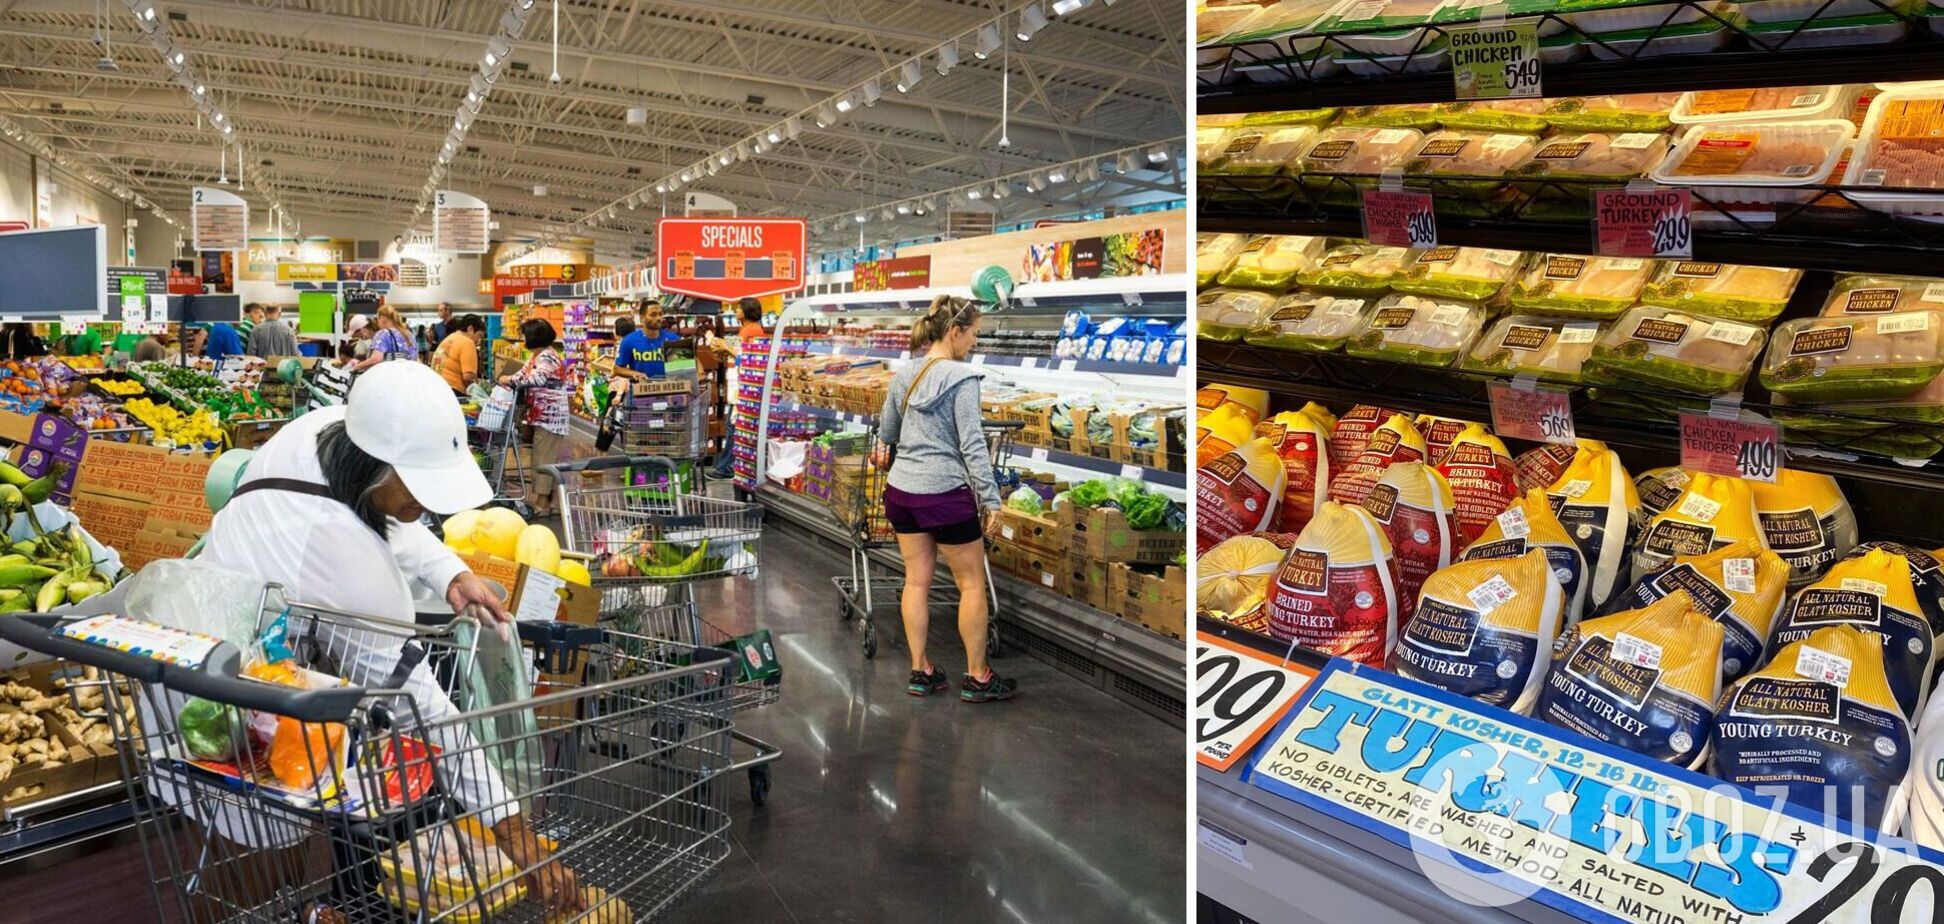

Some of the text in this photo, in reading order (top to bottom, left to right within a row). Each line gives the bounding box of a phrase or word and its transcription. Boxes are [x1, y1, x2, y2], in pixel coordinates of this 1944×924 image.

[195, 191, 204, 202] 2
[437, 193, 446, 205] 3
[688, 195, 696, 207] 4
[1603, 193, 1680, 208] GROUND
[1367, 206, 1406, 219] CHICKEN
[1600, 208, 1662, 224] TURKEY
[701, 225, 763, 248] SPECIALS
[1547, 267, 1579, 276] CHICKEN
[1678, 264, 1719, 274] CHICKEN
[1849, 300, 1892, 309] CHICKEN
[1523, 330, 1550, 338] NATURAL
[1637, 327, 1682, 340] CHICKEN
[1652, 321, 1686, 333] NATURAL
[1505, 336, 1546, 346] CHICKEN
[1812, 331, 1849, 341] NATURAL
[1794, 337, 1846, 352] CHICKEN
[639, 382, 685, 393] FRESH HERBS
[1695, 416, 1714, 427] ALL
[1683, 424, 1736, 444] CHICKEN
[1684, 438, 1737, 456] TENDERS
[1453, 453, 1490, 463] TURKEY
[1448, 468, 1487, 478] BRINED
[159, 508, 184, 521] FARM
[1776, 518, 1812, 531] NATURAL
[1657, 525, 1706, 541] ALL NATURAL
[1785, 531, 1818, 545] KOSHER
[1481, 543, 1517, 558] NATURAL
[1299, 558, 1325, 571] NATURAL
[1282, 566, 1323, 587] TURKEY
[1674, 569, 1720, 609] ALL NATURAL
[1275, 592, 1313, 612] BRINED
[1803, 593, 1870, 605] ALL NATURAL
[1797, 603, 1872, 617] GLATT KOSHER
[1286, 611, 1336, 629] TURKEY
[1419, 606, 1468, 630] ALL NATURAL
[1428, 625, 1467, 646] KOSHER
[1585, 643, 1602, 658] ALL
[1420, 655, 1479, 679] TURKEY
[1573, 653, 1642, 698] GLATT KOSHER
[1749, 682, 1828, 700] ALL NATURAL
[1550, 670, 1587, 703] YOUNG
[1587, 694, 1649, 738] TURKEY
[1739, 695, 1831, 714] GLATT KOSHER
[1362, 687, 1443, 719] GLATT
[1446, 709, 1550, 759] KOSHER,
[1719, 722, 1853, 747] YOUNG TURKEY
[1203, 745, 1230, 760] POUND
[1213, 740, 1233, 751] PER
[1771, 749, 1807, 758] PROCESSED
[1807, 749, 1822, 758] AND
[1779, 756, 1821, 765] INGREDIENTS
[1792, 774, 1801, 782] OR
[1801, 775, 1826, 784] FROZEN
[1294, 688, 1799, 917] TURKEYS
[1279, 746, 1744, 924] NO GIBLETS. ARE WASHED AND SALTED WITH
[1462, 835, 1565, 885] METHOD.
[1568, 879, 1605, 905] ALL
